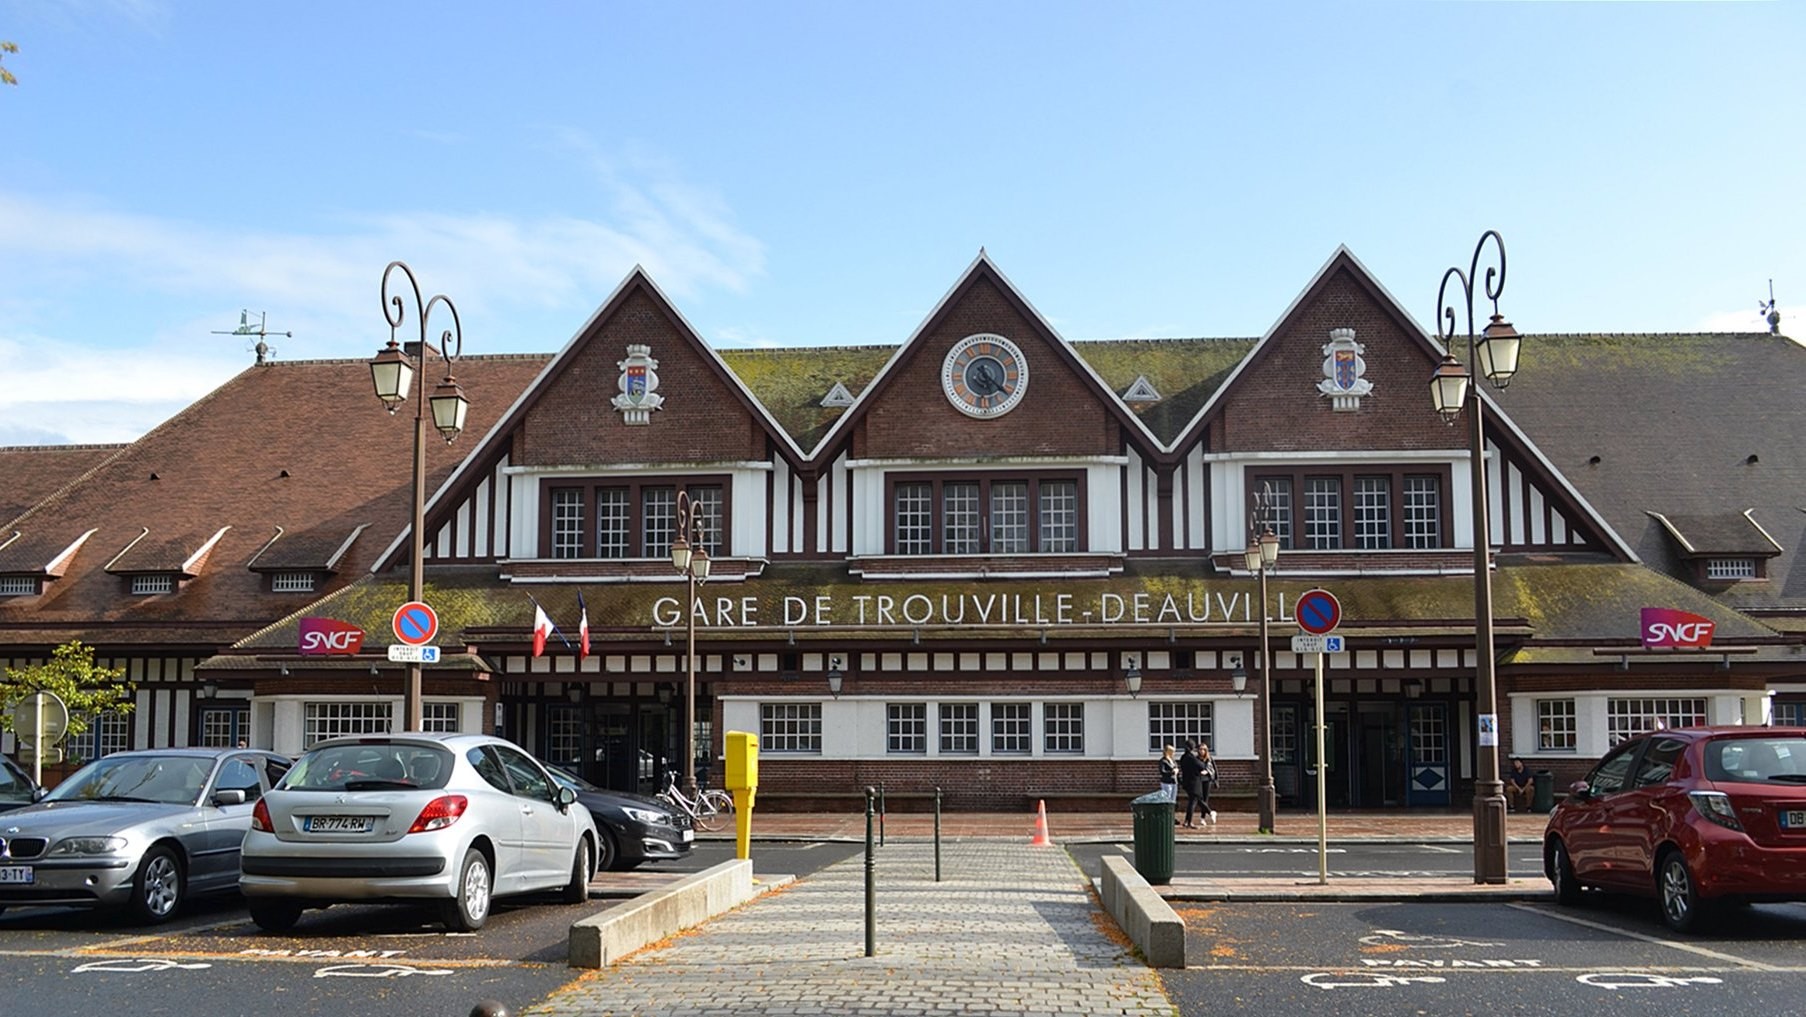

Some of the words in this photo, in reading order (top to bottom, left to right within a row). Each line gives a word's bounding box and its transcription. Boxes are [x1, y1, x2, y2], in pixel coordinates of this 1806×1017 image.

[652, 596, 757, 626] GARE
[784, 596, 832, 625] DE
[302, 631, 362, 650] SNCF
[1646, 622, 1712, 643] SNCF
